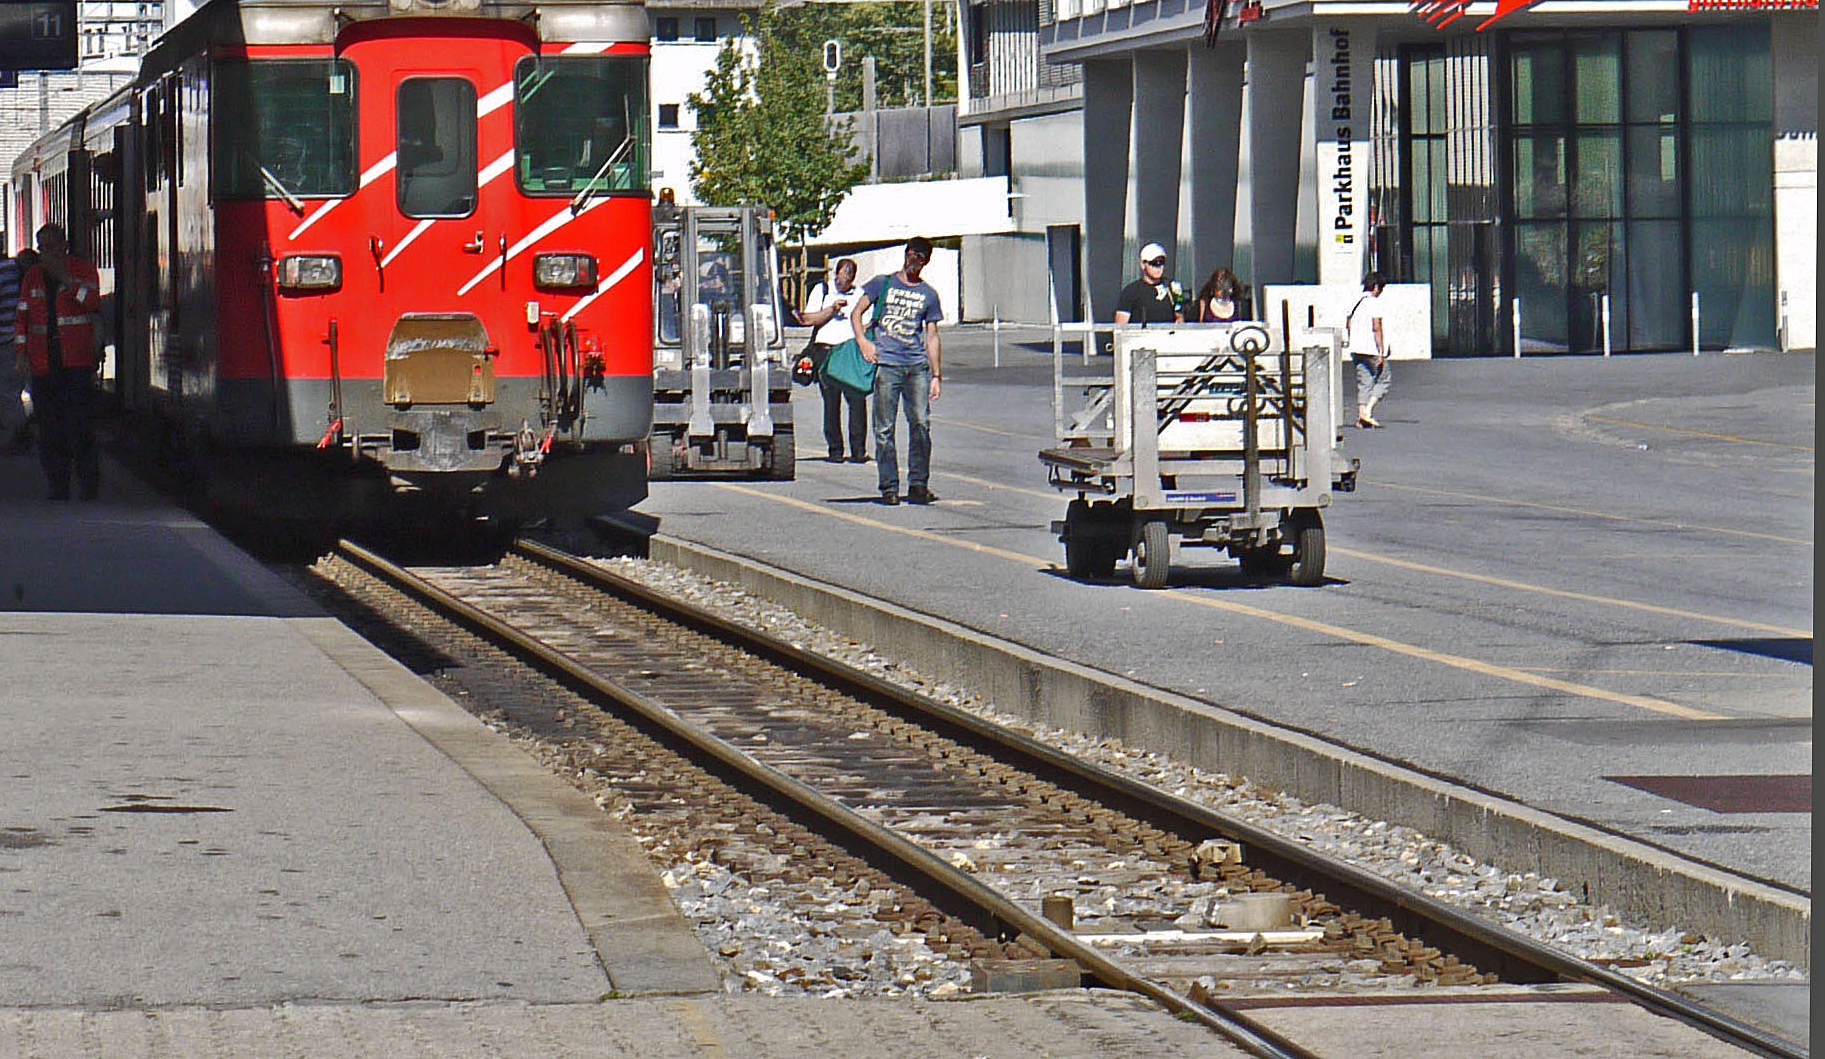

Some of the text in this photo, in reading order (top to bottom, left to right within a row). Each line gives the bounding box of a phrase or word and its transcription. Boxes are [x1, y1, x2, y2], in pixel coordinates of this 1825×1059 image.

[38, 13, 62, 37] 11
[1330, 28, 1354, 230] Parkhaus Bahnhof
